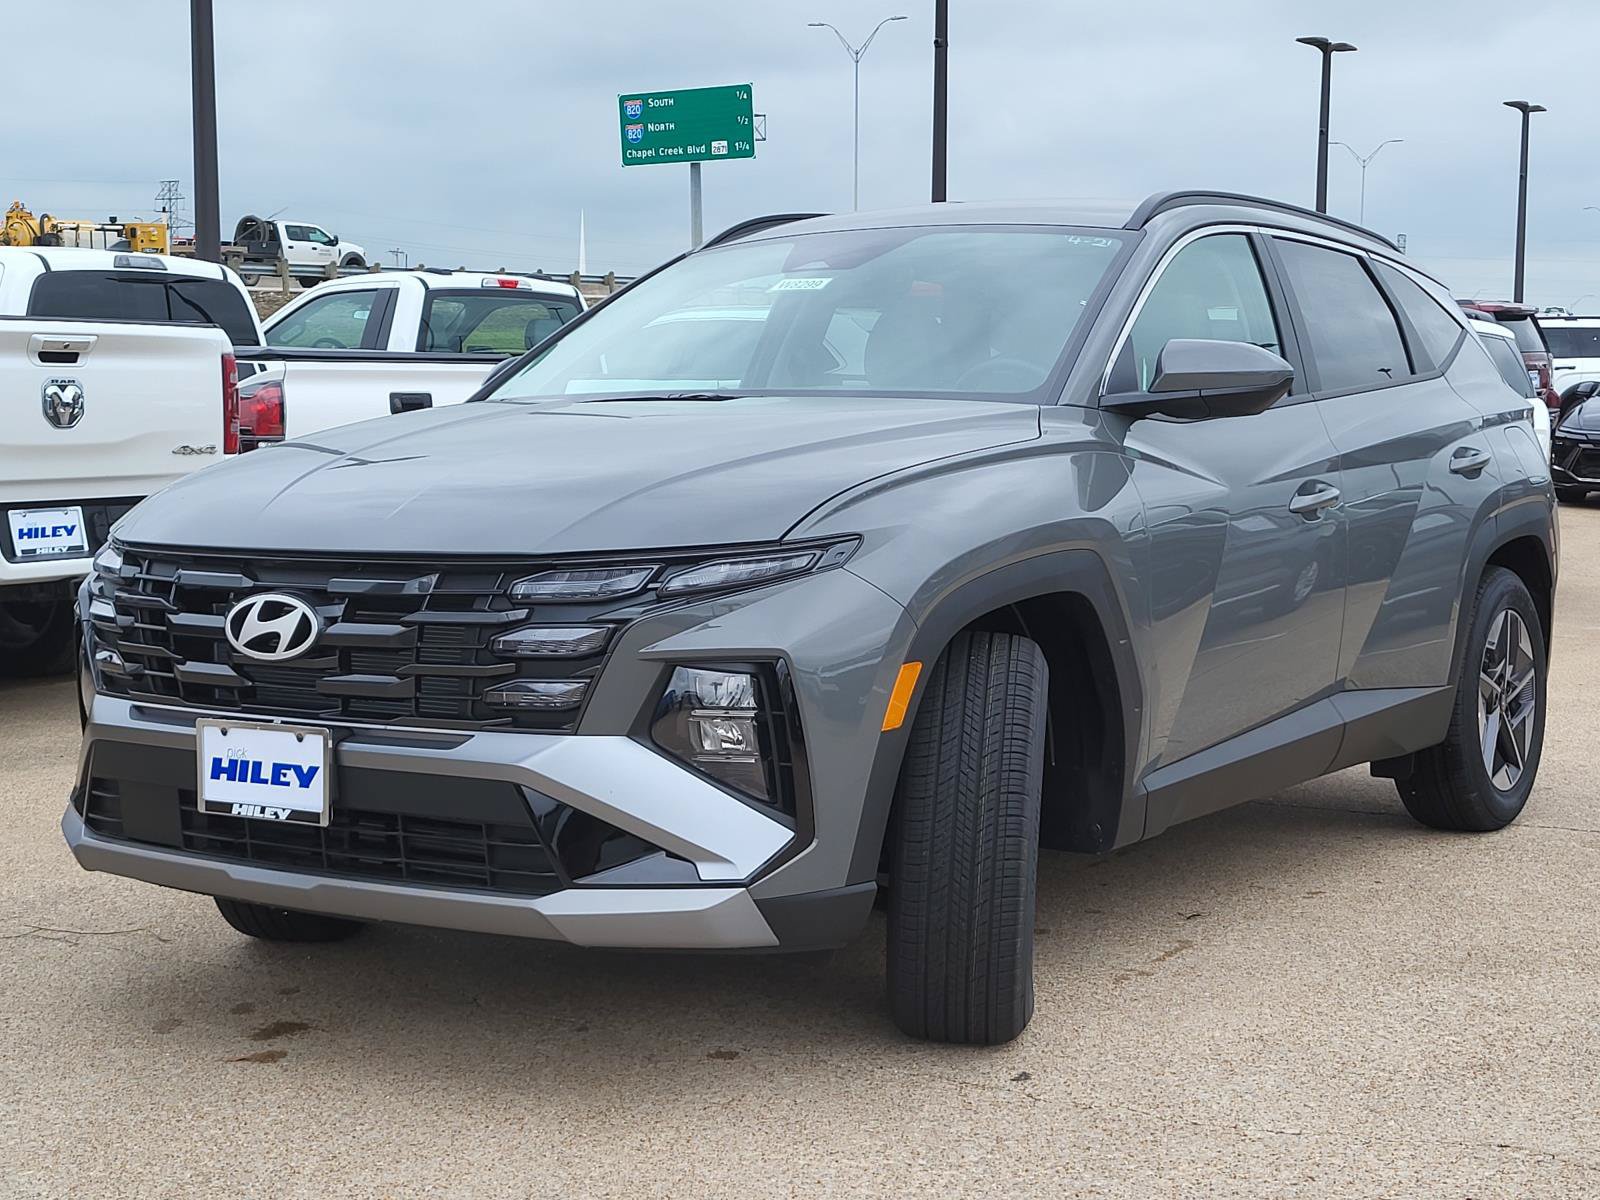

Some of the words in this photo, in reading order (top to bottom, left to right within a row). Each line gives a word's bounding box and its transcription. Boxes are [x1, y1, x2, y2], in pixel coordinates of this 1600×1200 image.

[626, 105, 641, 115] 820
[627, 129, 642, 139] 820
[626, 148, 656, 159] Chapel
[659, 146, 684, 156] Creek
[687, 144, 706, 154] Blvd
[17, 524, 77, 540] HILEY
[36, 546, 69, 555] HILEY
[227, 746, 248, 760] pick
[210, 756, 320, 789] HILEY
[231, 803, 292, 820] HILEY
